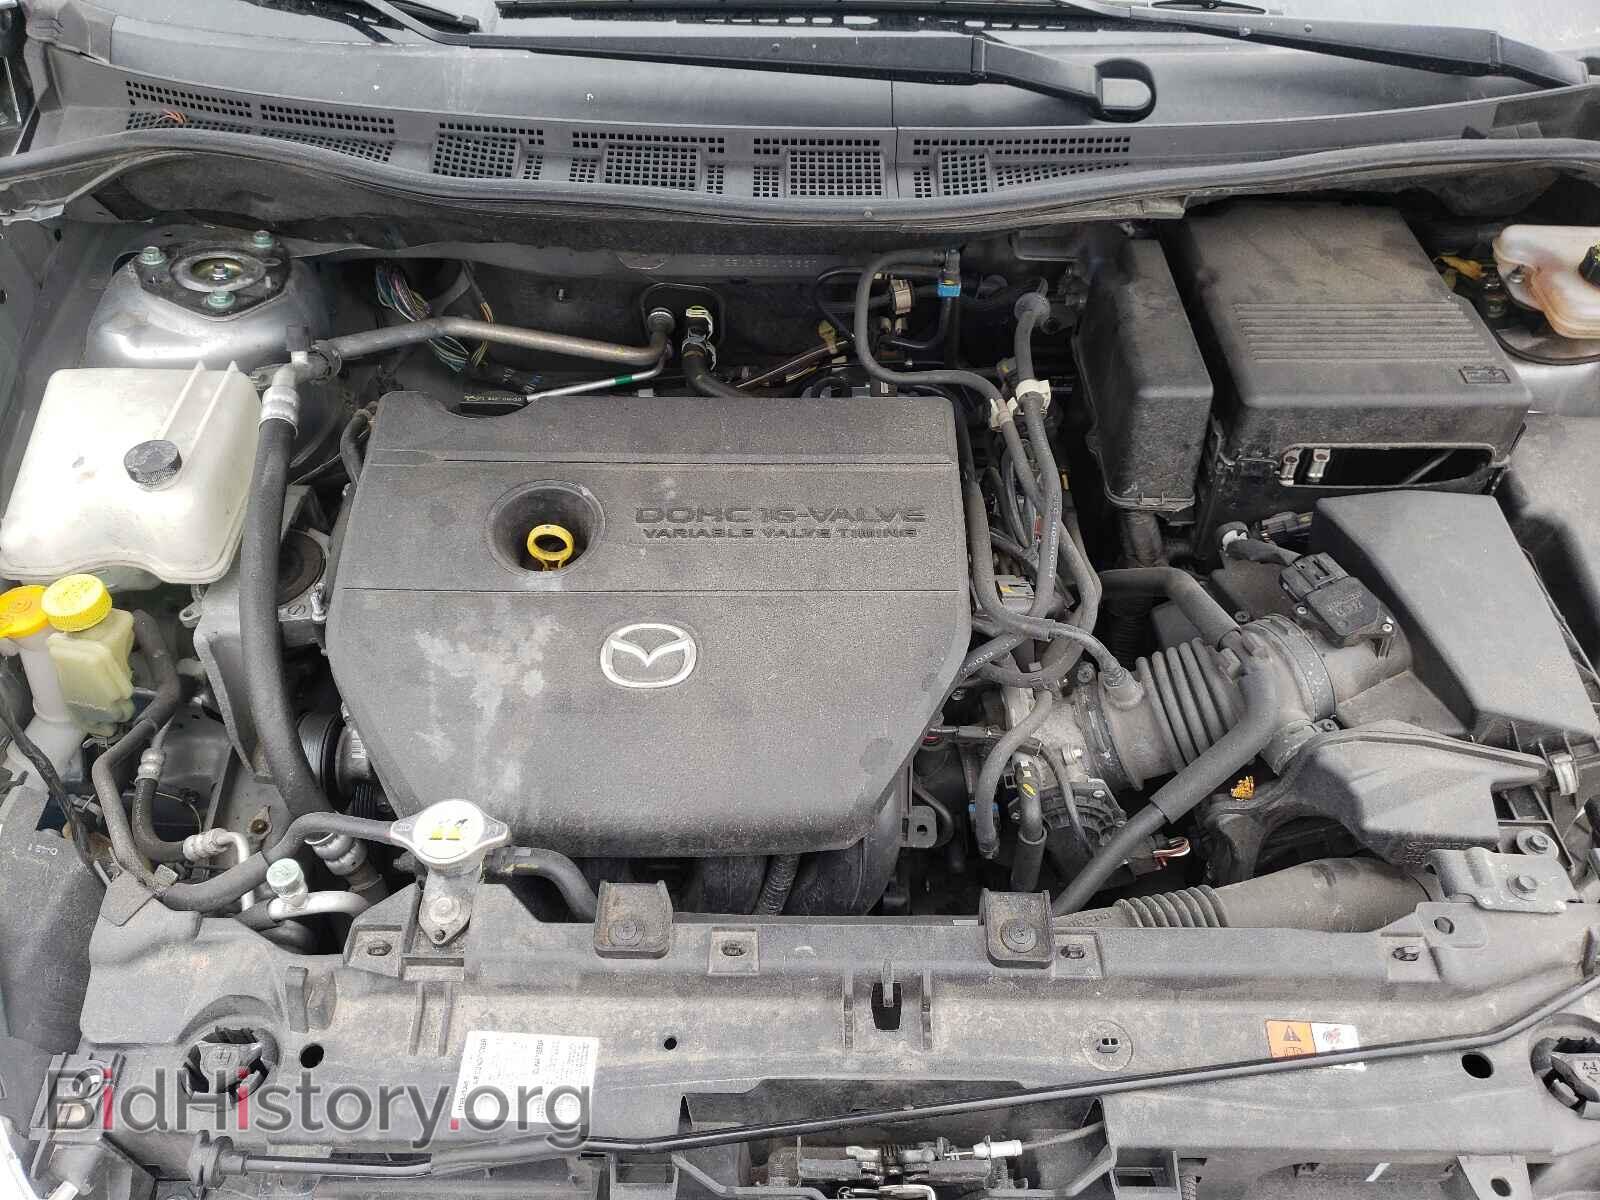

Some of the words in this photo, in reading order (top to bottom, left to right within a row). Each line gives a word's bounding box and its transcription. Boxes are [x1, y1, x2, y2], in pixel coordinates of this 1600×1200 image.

[635, 507, 752, 524] DOHC
[760, 507, 927, 524] 16-VALVE
[642, 527, 754, 539] VARIABLE
[761, 527, 831, 539] VALVE
[839, 527, 918, 539] TIMING
